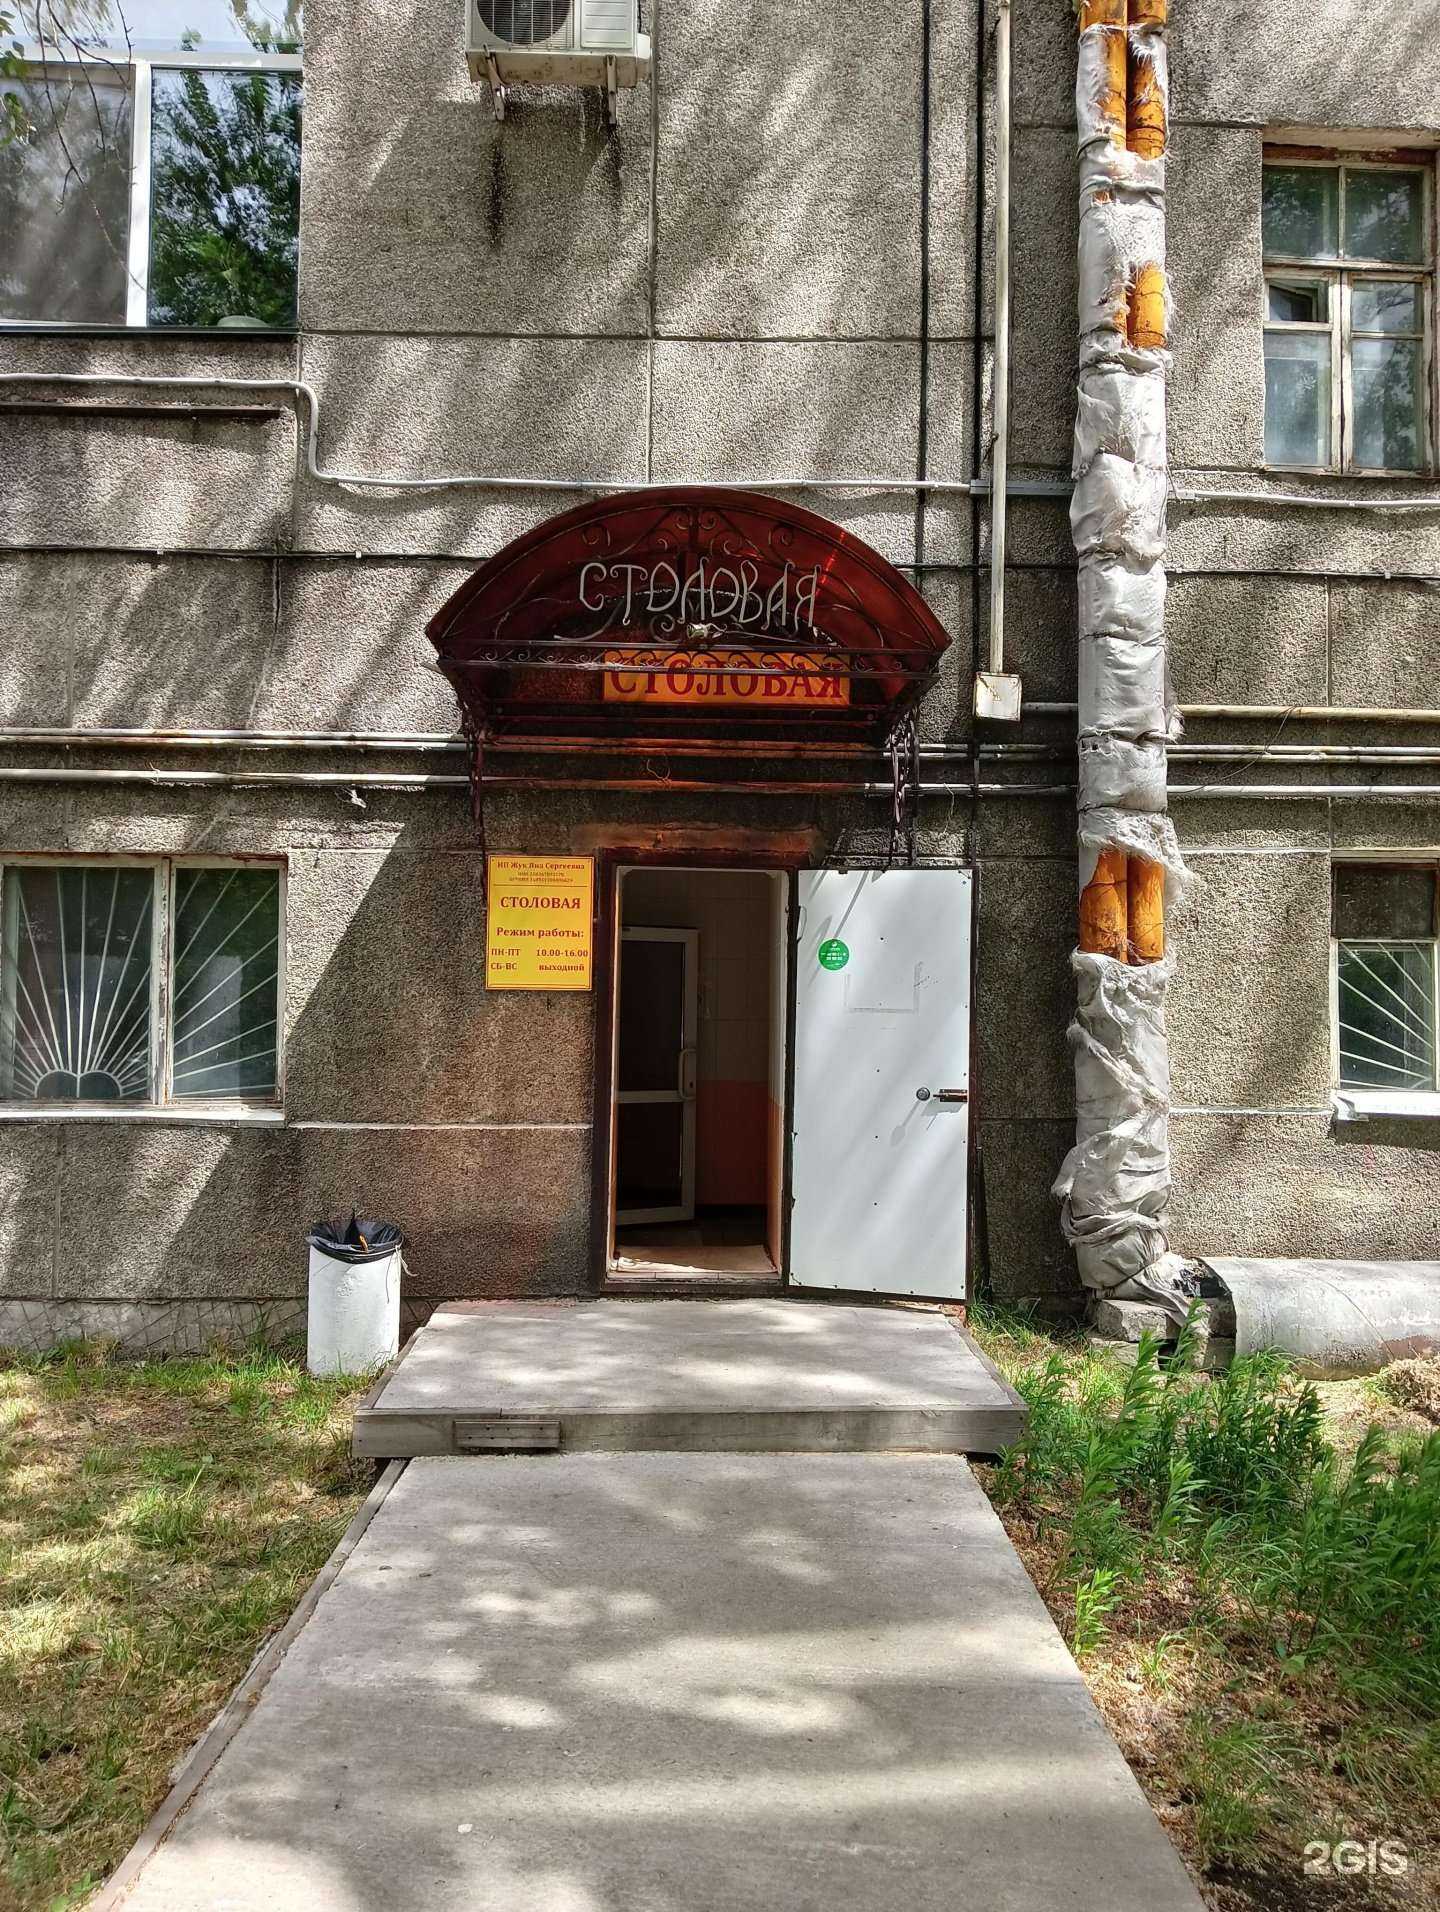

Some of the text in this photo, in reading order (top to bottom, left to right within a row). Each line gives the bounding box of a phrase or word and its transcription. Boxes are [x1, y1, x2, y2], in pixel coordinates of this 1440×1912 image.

[579, 557, 821, 631] СТОЛОВАЯ
[610, 659, 843, 698] СТОЛОВАЯ
[497, 861, 509, 869] ИП
[510, 861, 527, 870] Жук
[500, 896, 581, 909] СТОЛОВАЯ
[496, 927, 584, 939] Режим работы:
[491, 948, 588, 957] ПН-ПТ 10.00-16.00
[490, 962, 585, 972] СБ-ВС выходной
